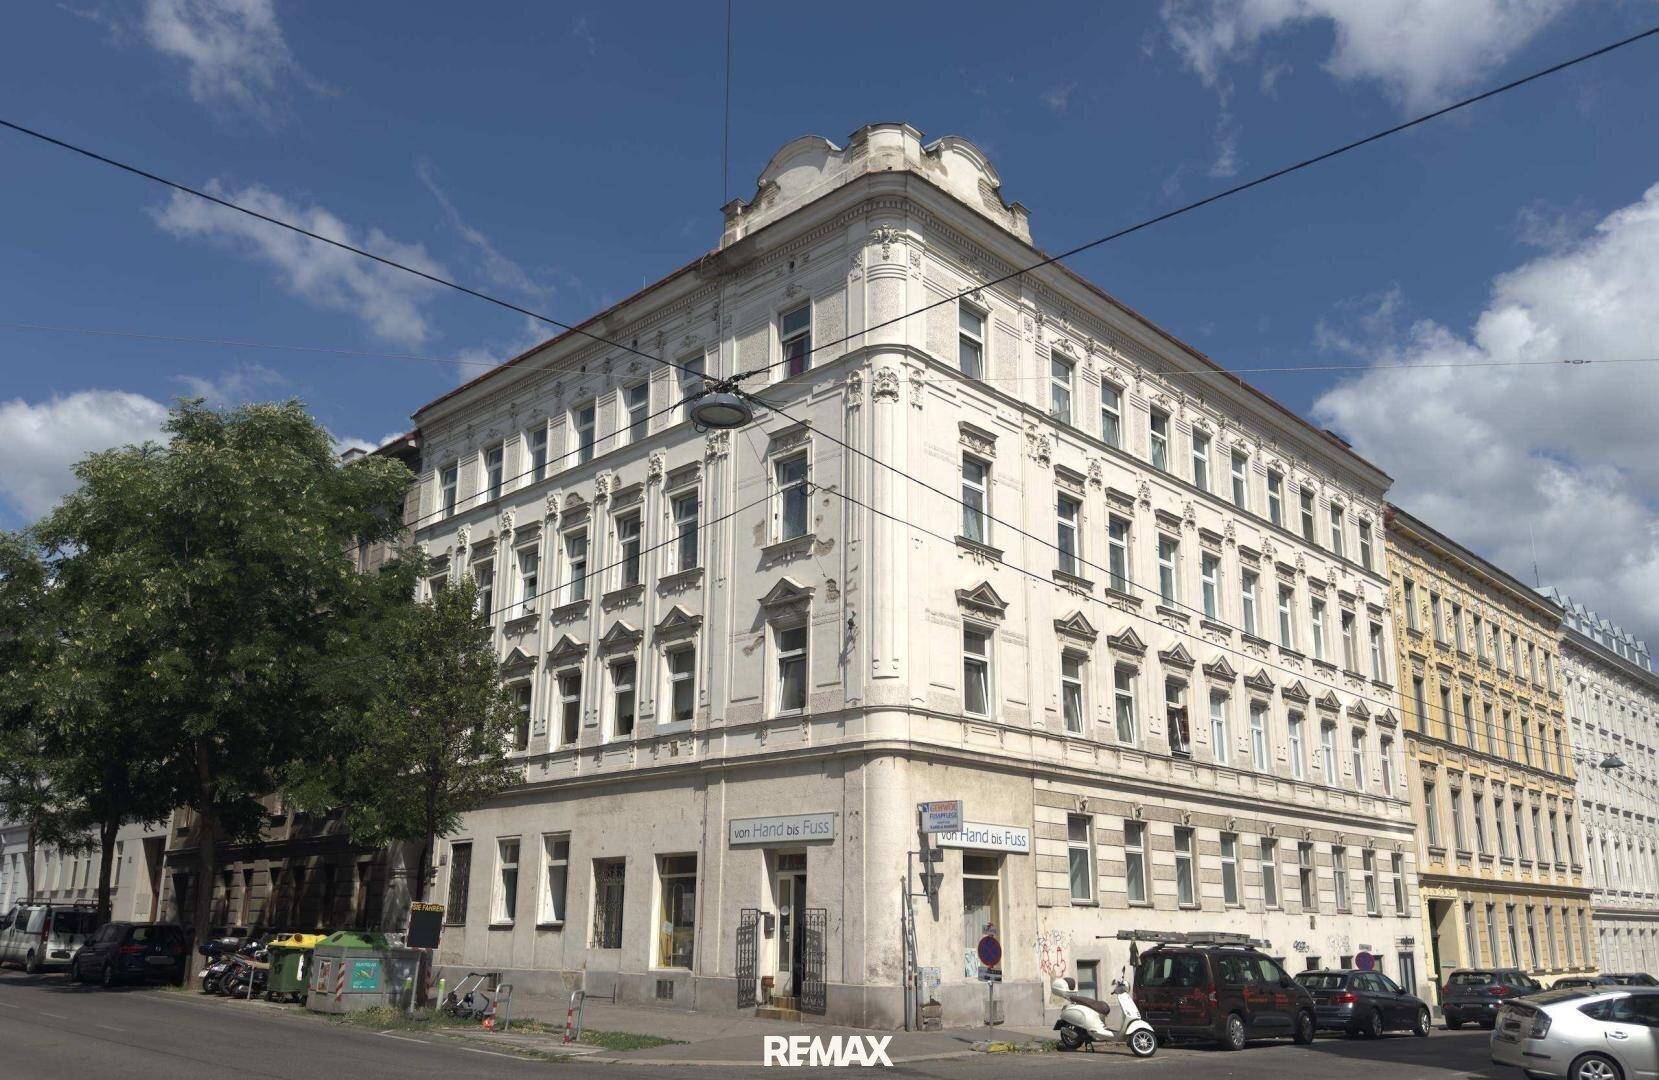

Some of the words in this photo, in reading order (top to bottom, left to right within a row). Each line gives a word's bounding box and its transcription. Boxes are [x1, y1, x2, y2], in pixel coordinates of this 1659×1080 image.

[734, 828, 750, 838] von
[753, 822, 784, 837] Hand
[786, 824, 799, 836] bis
[803, 820, 829, 835] Fuss
[960, 828, 988, 843] Hand
[991, 834, 1002, 845] bis
[1005, 831, 1026, 846] Fuss
